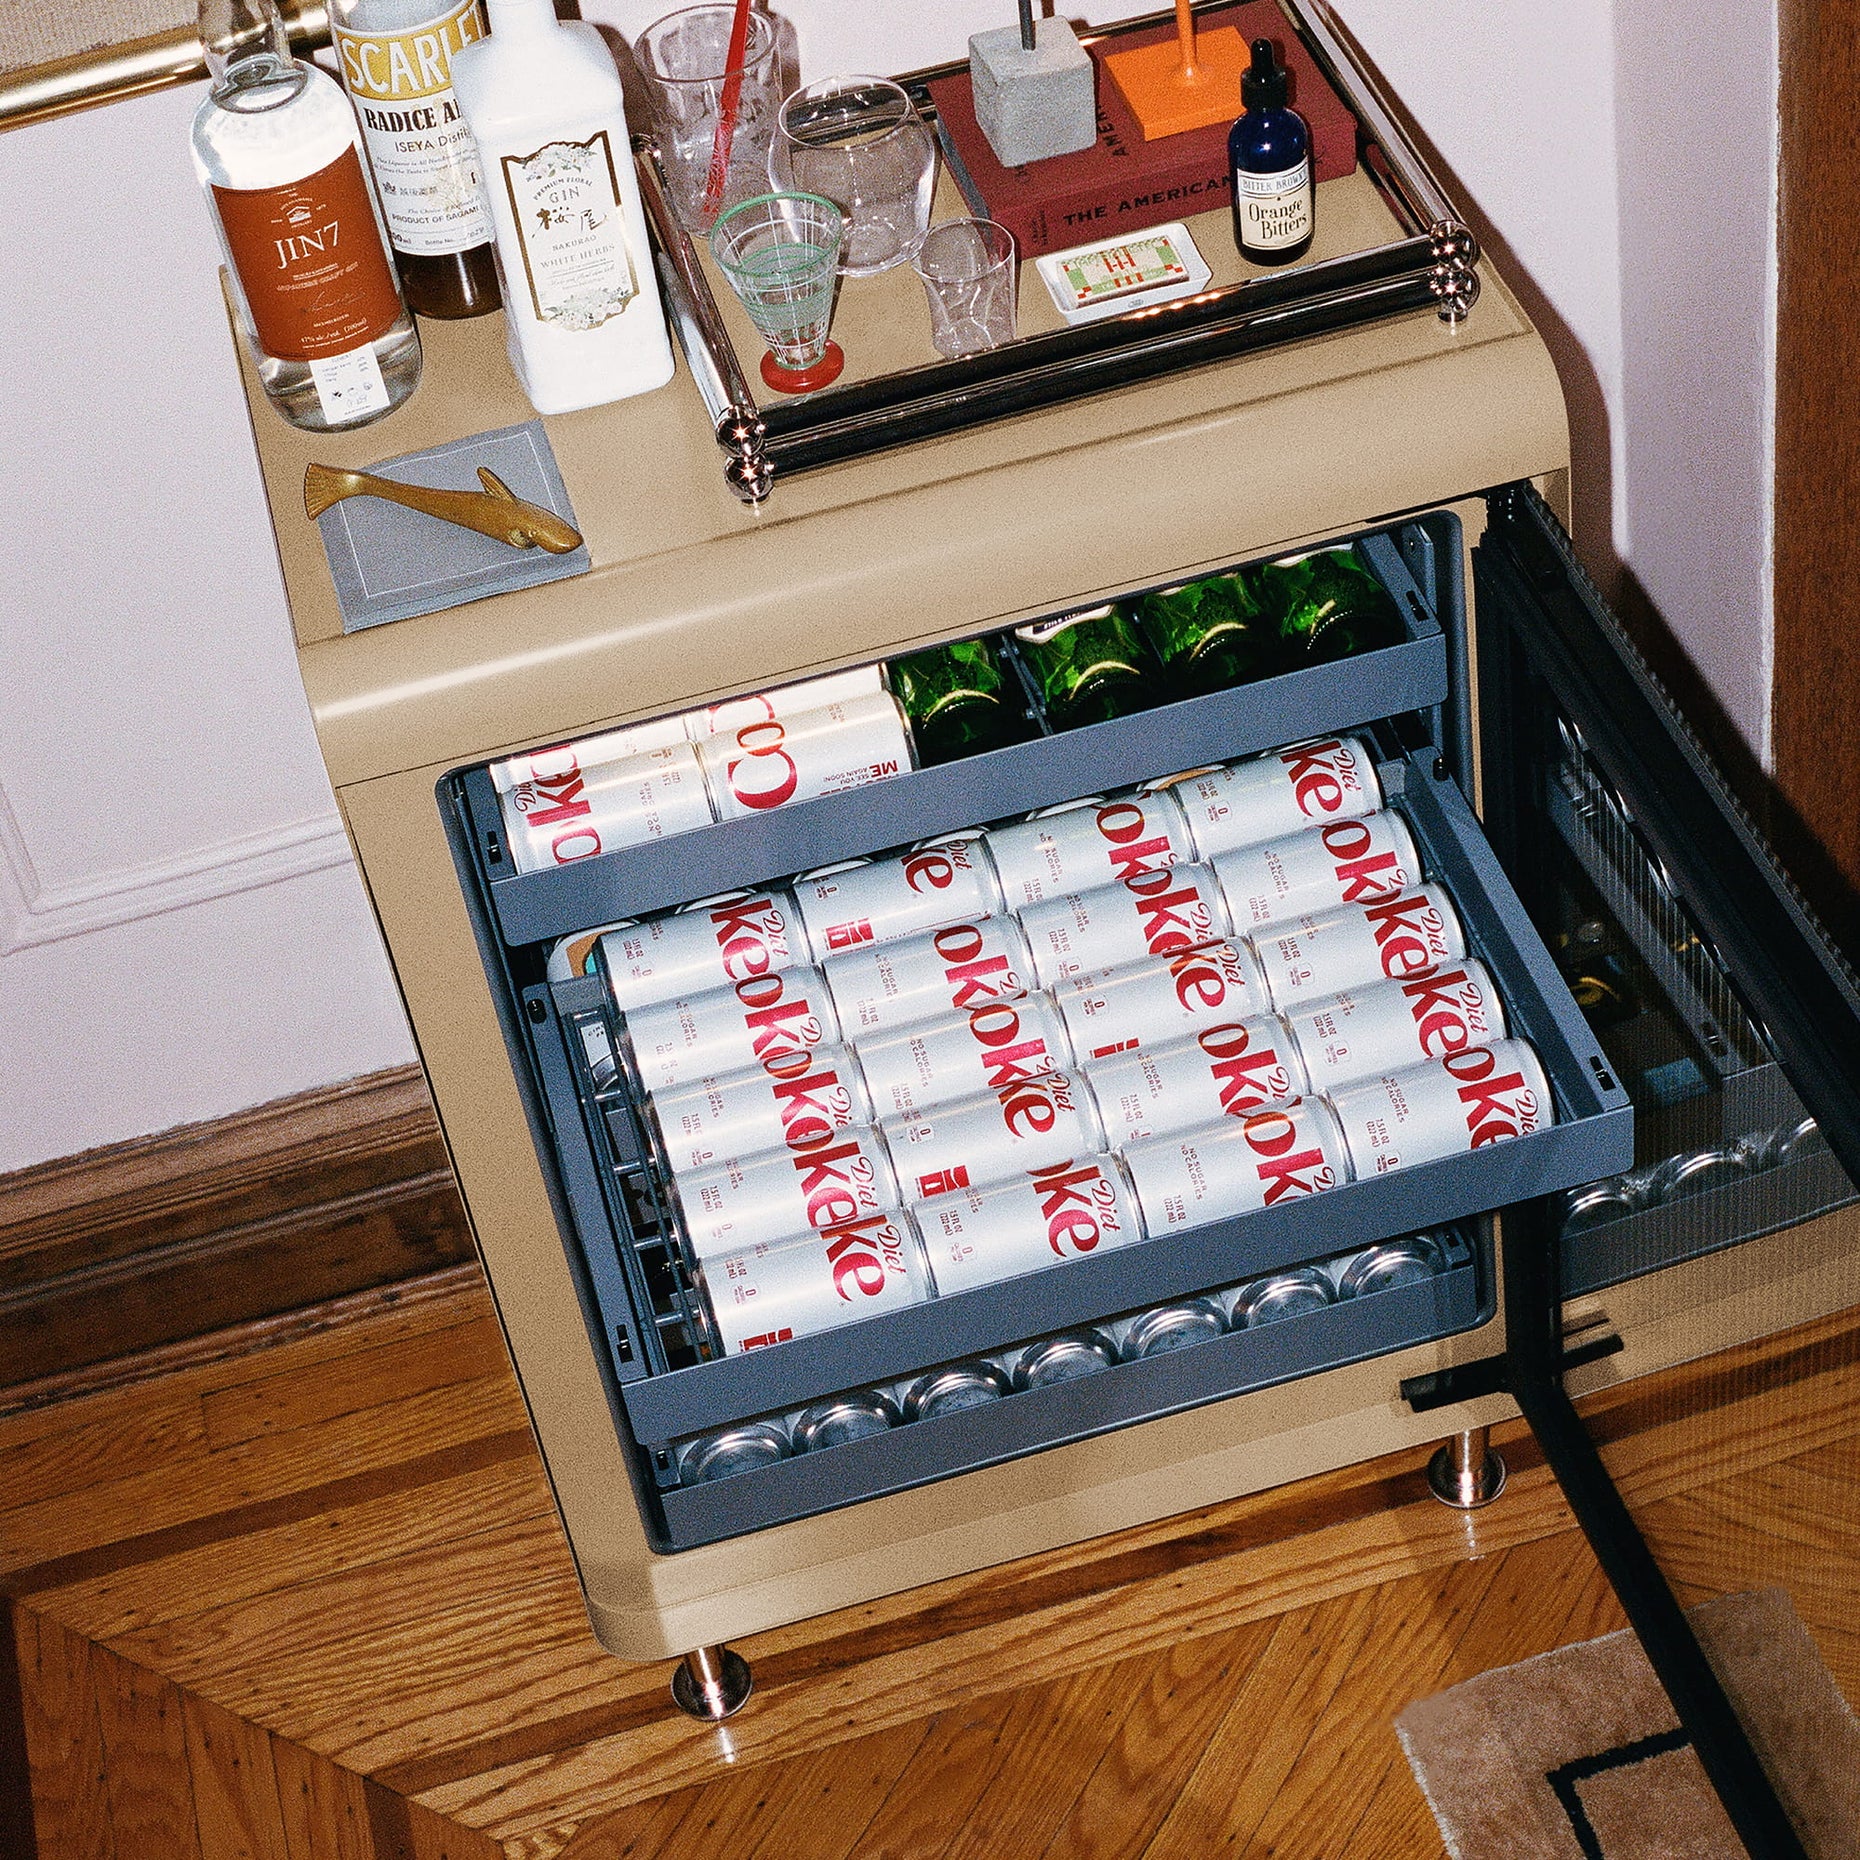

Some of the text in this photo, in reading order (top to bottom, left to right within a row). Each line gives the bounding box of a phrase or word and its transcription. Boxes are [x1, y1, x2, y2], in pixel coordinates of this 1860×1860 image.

[363, 107, 437, 133] RADICE
[395, 139, 435, 153] ISEYA
[550, 186, 580, 203] GIN
[1249, 200, 1302, 222] Orange
[391, 213, 429, 224] PRODUCT
[432, 215, 442, 223] OF
[1063, 206, 1108, 226] THE
[1262, 213, 1307, 239] Bitters
[273, 220, 339, 269] JIN7
[870, 760, 898, 778] ME
[1283, 743, 1351, 816] ke
[1333, 749, 1362, 796] Diet
[1097, 805, 1170, 880] ok
[1322, 822, 1403, 902] ok
[1276, 864, 1289, 891] SUGAR
[712, 901, 785, 979] ke
[763, 910, 789, 956] Diet
[1190, 902, 1219, 945] Die
[1356, 890, 1442, 978] ke
[1421, 907, 1448, 956] Diet
[884, 967, 898, 994] SUGAR
[935, 926, 1014, 1008] ok
[1161, 939, 1236, 1011] ke
[1216, 944, 1246, 991] Diet
[1300, 970, 1311, 978] 0
[1094, 1001, 1105, 1009] 0
[1388, 965, 1481, 1057] ke
[1459, 983, 1488, 1033] Diet
[686, 1014, 697, 1039] SUGAR
[916, 1039, 931, 1074] NO SUGAR
[1336, 1048, 1347, 1056] 0
[1047, 1073, 1076, 1111] Diet
[1140, 1060, 1158, 1099] CALORIES
[1148, 1064, 1162, 1091] SUGAR
[1444, 1048, 1533, 1148] oke
[829, 1086, 852, 1128] Die
[993, 1071, 1066, 1136] ke
[1385, 1083, 1404, 1123] CALORIES
[1394, 1088, 1409, 1116] SUGAR
[1515, 1089, 1539, 1136] Die
[1244, 1112, 1329, 1205] ok
[1381, 1136, 1389, 1144] OZ
[1387, 1157, 1398, 1165] 0
[787, 1132, 874, 1228] ke
[850, 1156, 878, 1207] Diet
[1180, 1145, 1203, 1201] NO CALORIES
[1188, 1148, 1207, 1191] NO SUGAR
[714, 1201, 723, 1209] OZ
[1029, 1160, 1115, 1255] ke
[1091, 1179, 1120, 1231] Diet
[1164, 1200, 1174, 1211] (222
[1175, 1205, 1184, 1213] FL
[1178, 1212, 1186, 1220] OZ
[877, 1224, 907, 1273] Diet
[954, 1224, 963, 1233] OZ
[821, 1215, 897, 1300] ke
